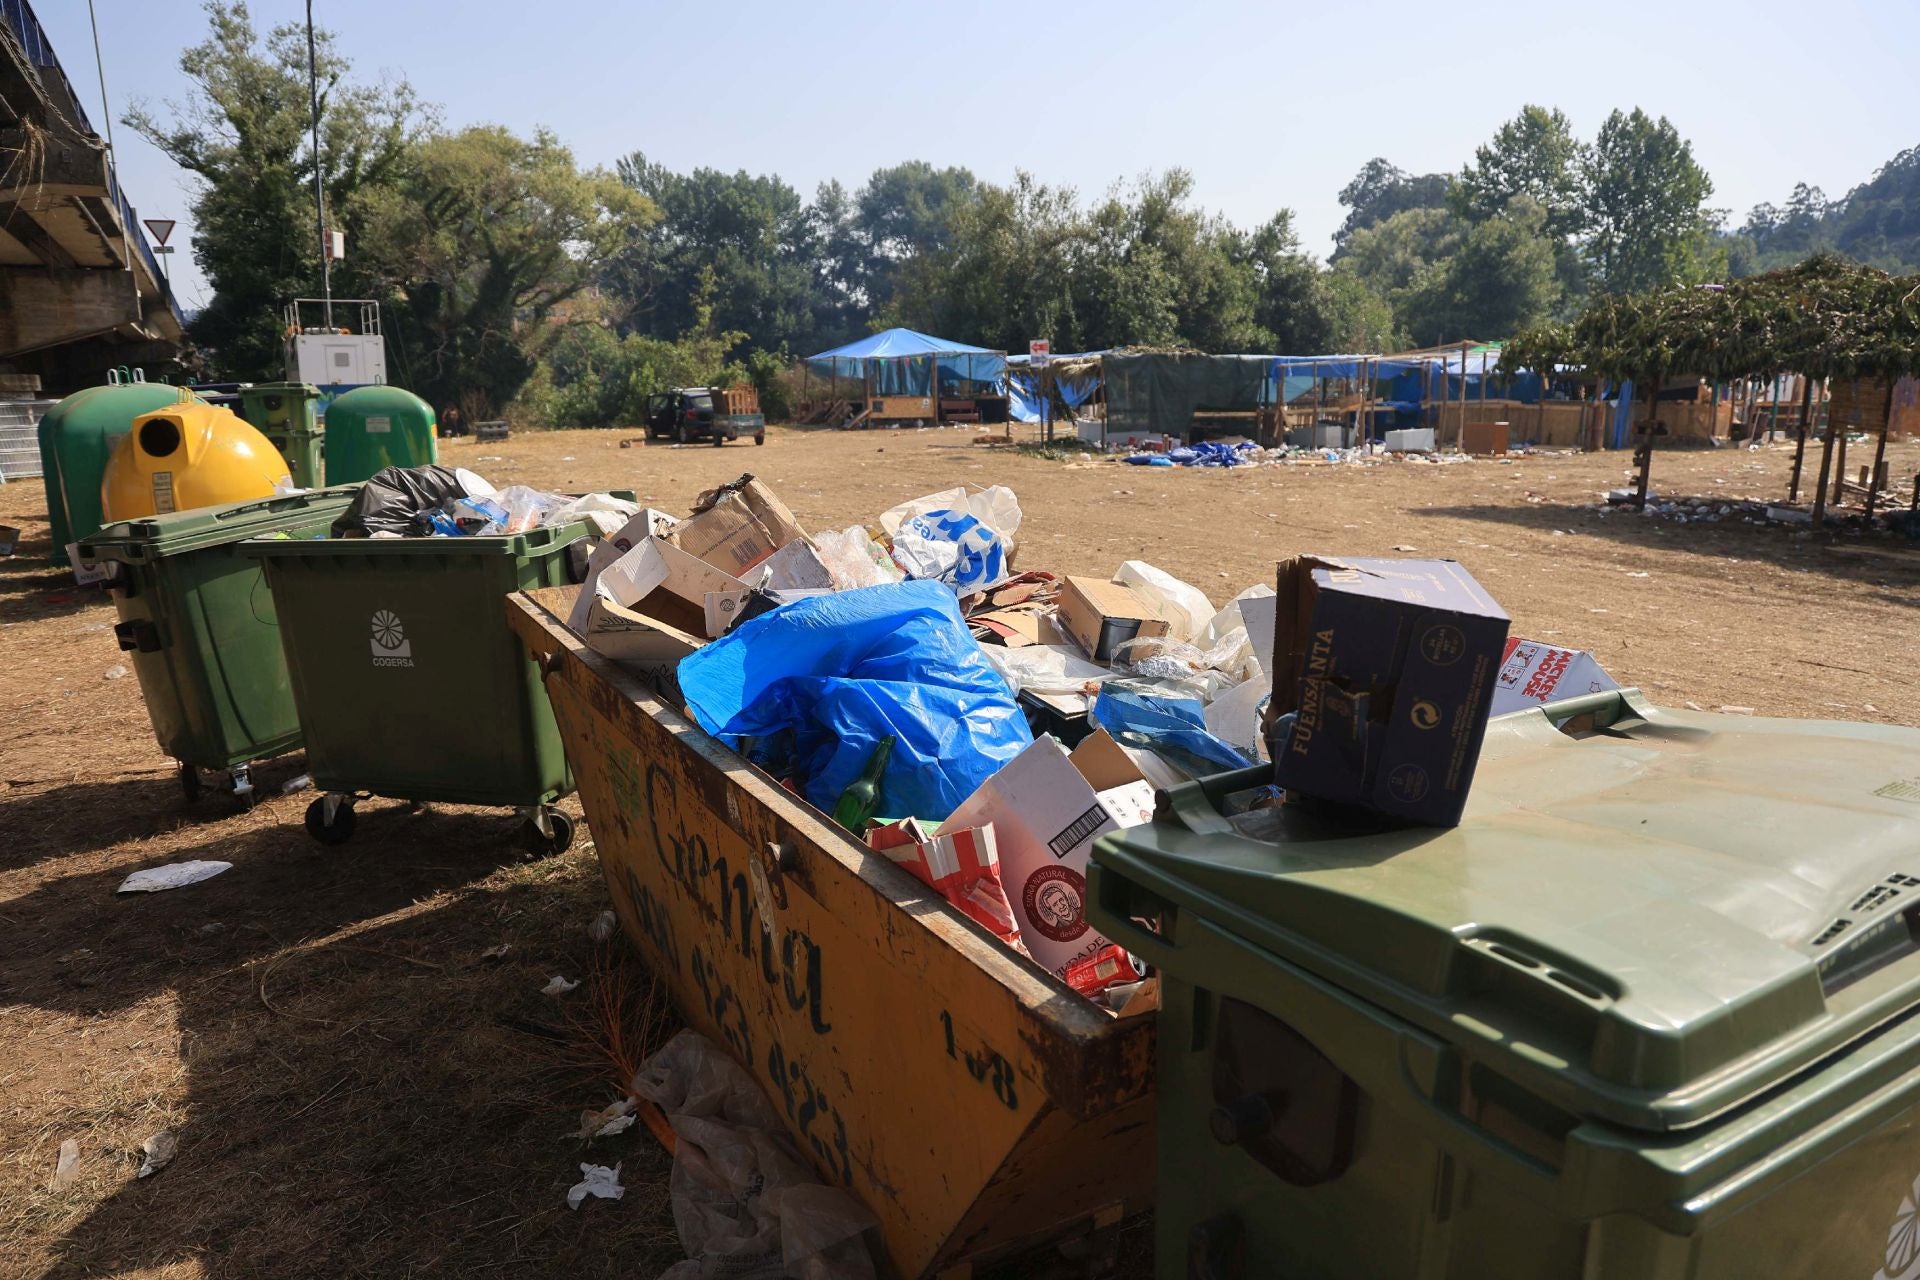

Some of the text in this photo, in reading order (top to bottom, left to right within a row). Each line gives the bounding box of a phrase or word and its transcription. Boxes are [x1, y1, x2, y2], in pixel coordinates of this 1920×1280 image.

[372, 657, 415, 668] COGERSA
[1521, 648, 1559, 697] MOUSE
[1535, 650, 1574, 702] MICKEY
[1293, 628, 1335, 756] FUENSANTA
[1026, 870, 1067, 908] SIDRA NATURAL
[1086, 936, 1105, 954] DE
